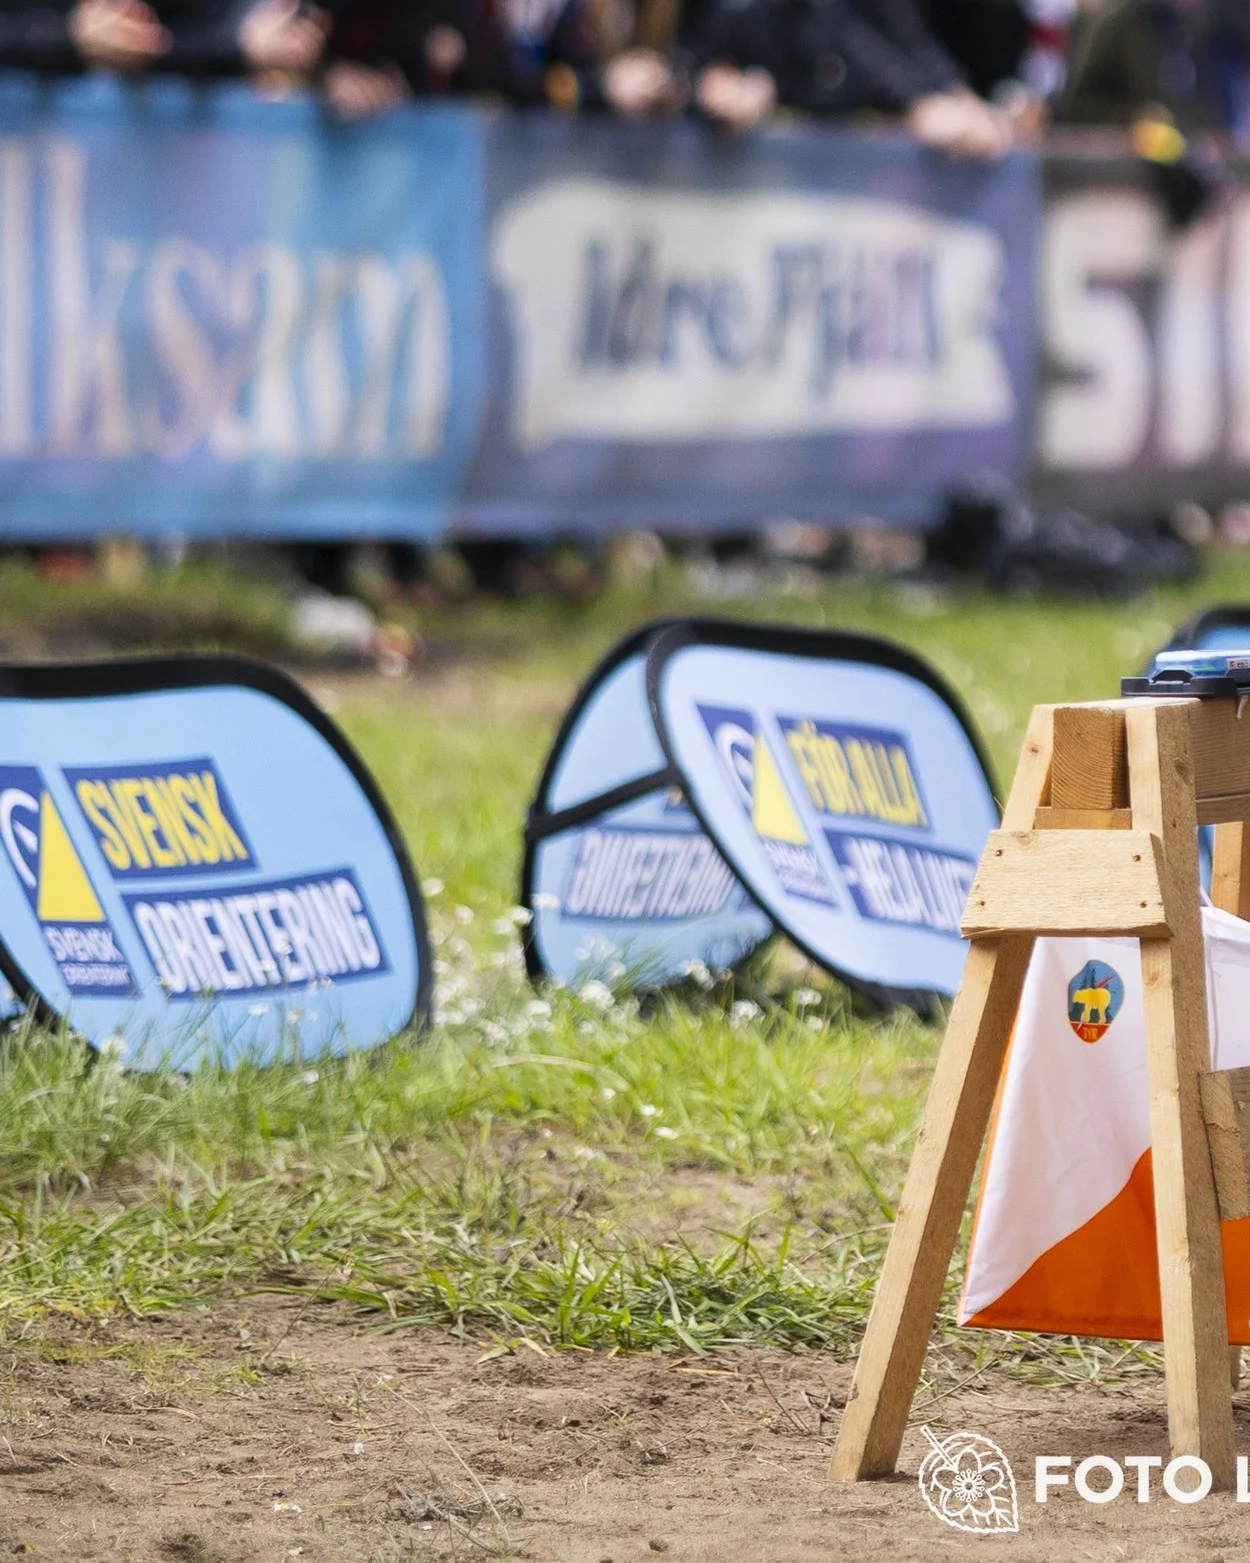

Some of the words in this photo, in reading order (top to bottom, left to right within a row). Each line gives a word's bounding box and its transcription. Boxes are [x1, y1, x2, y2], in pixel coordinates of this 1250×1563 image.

[76, 770, 249, 870] SVENSK
[134, 877, 381, 994] ORIENTERING
[1083, 1026, 1098, 1040] TYR
